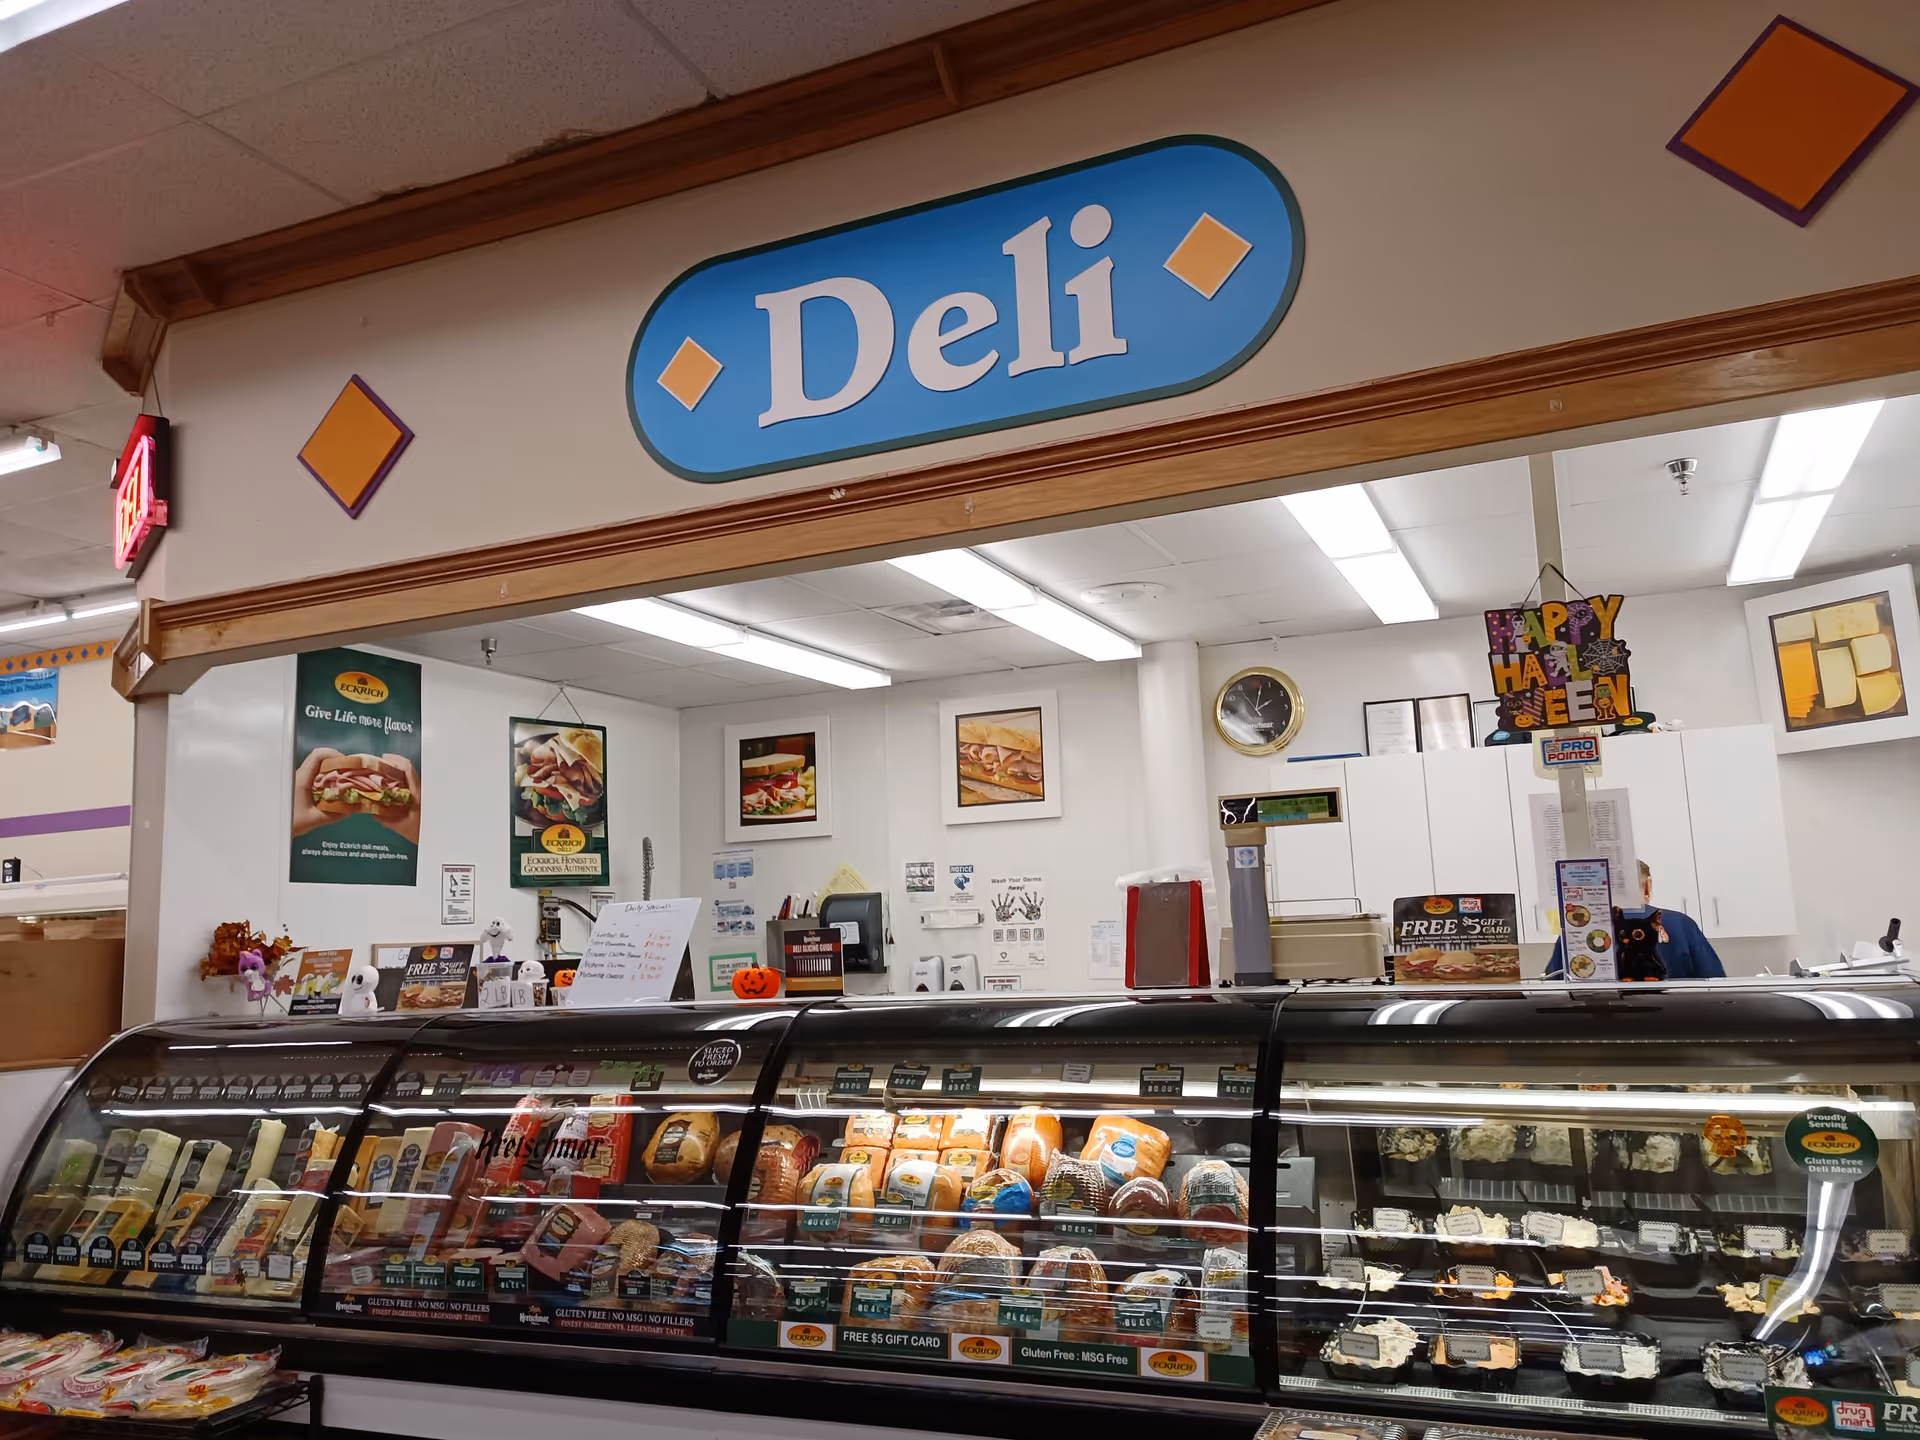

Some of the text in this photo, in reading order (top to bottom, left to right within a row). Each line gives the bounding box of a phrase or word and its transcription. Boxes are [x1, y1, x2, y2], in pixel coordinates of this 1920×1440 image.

[755, 204, 1127, 428] Deli
[1486, 595, 1624, 652] HAPPY
[340, 682, 384, 698] ECKRICH
[305, 704, 413, 735] Give Life more flavor
[1561, 740, 1593, 751] PRO
[1548, 750, 1594, 762] POINTS
[322, 841, 338, 850] Enjoy
[340, 842, 360, 850] Eckrich
[561, 856, 587, 864] HONEST
[524, 864, 600, 873] GOODNESS AUTHENTIC
[1400, 916, 1480, 936] FREE $5
[406, 962, 449, 976] FREE $5
[1806, 1114, 1846, 1122] Proudly
[1808, 1121, 1848, 1130] Serving
[475, 1128, 604, 1166] Kretschmar
[1808, 1142, 1855, 1150] ECKRICH
[1804, 1157, 1838, 1165] Gluten
[368, 1298, 490, 1312] GLUTEN FREE NO MSG NO FILLERS
[430, 1312, 463, 1320] LEGENDARY
[556, 1308, 694, 1327] GLUTEN FREE NO MSG NO FILLERS
[561, 1320, 582, 1328] FINEST
[627, 1324, 664, 1334] LEGENDARY
[790, 1333, 823, 1344] ECKRICH
[843, 1331, 940, 1348] FREE $5 GIFT CARD
[962, 1345, 999, 1356] ECKRICH
[1021, 1346, 1051, 1358] Gluten
[1053, 1350, 1075, 1360] Free
[1082, 1351, 1104, 1363] MSG
[1106, 1354, 1128, 1364] Free
[1152, 1361, 1193, 1372] ECKRICH
[1836, 1402, 1866, 1419] drug
[1882, 1402, 1920, 1423] FR
[1840, 1418, 1875, 1428] mart
